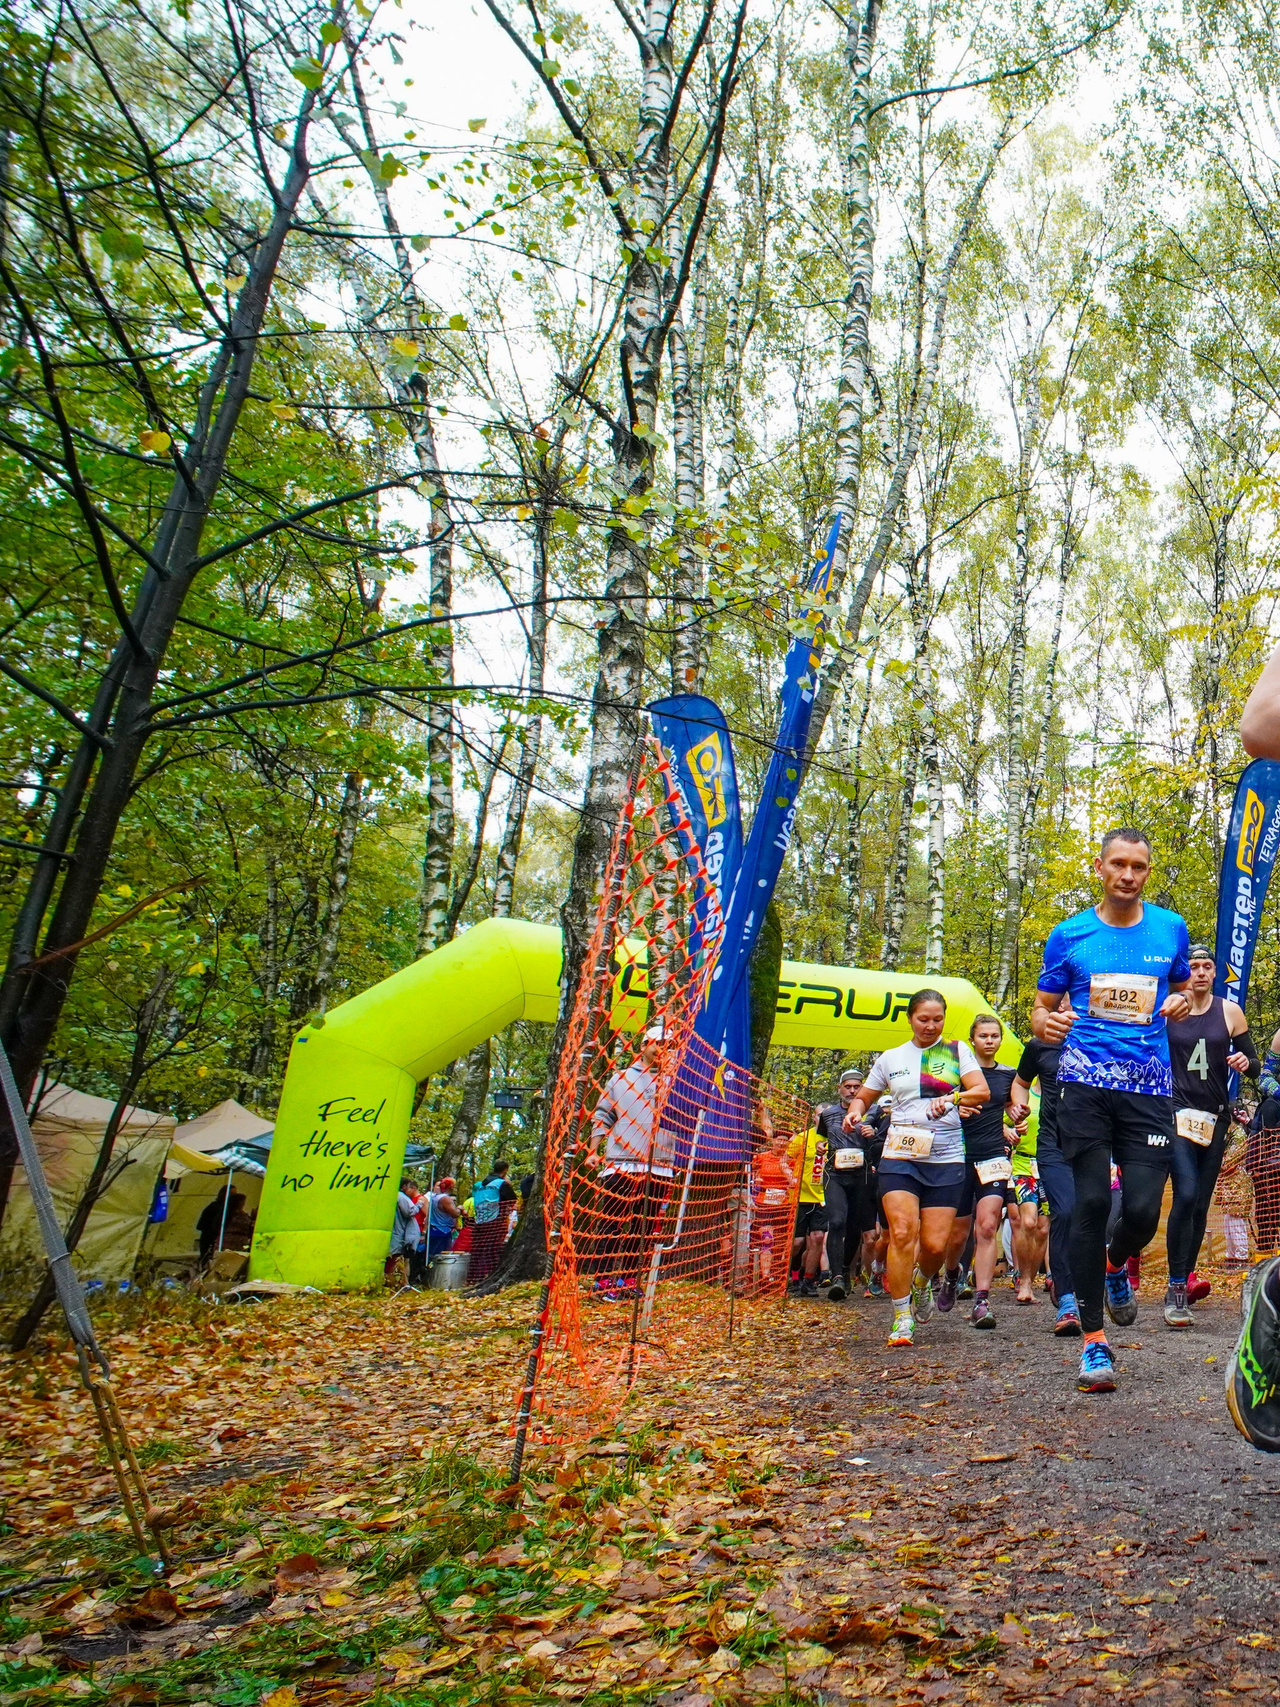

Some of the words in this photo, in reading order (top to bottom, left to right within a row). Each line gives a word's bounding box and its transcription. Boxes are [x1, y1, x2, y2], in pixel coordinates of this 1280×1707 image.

[1109, 988, 1137, 1003] 102
[1103, 1000, 1140, 1012] Владимир
[1187, 1038, 1209, 1080] 4
[318, 1096, 386, 1126] Feel
[1187, 1119, 1204, 1131] 121
[299, 1130, 389, 1160] there's
[901, 1136, 915, 1146] 60
[991, 1163, 1003, 1171] 91
[281, 1173, 314, 1192] no
[328, 1161, 390, 1192] limit
